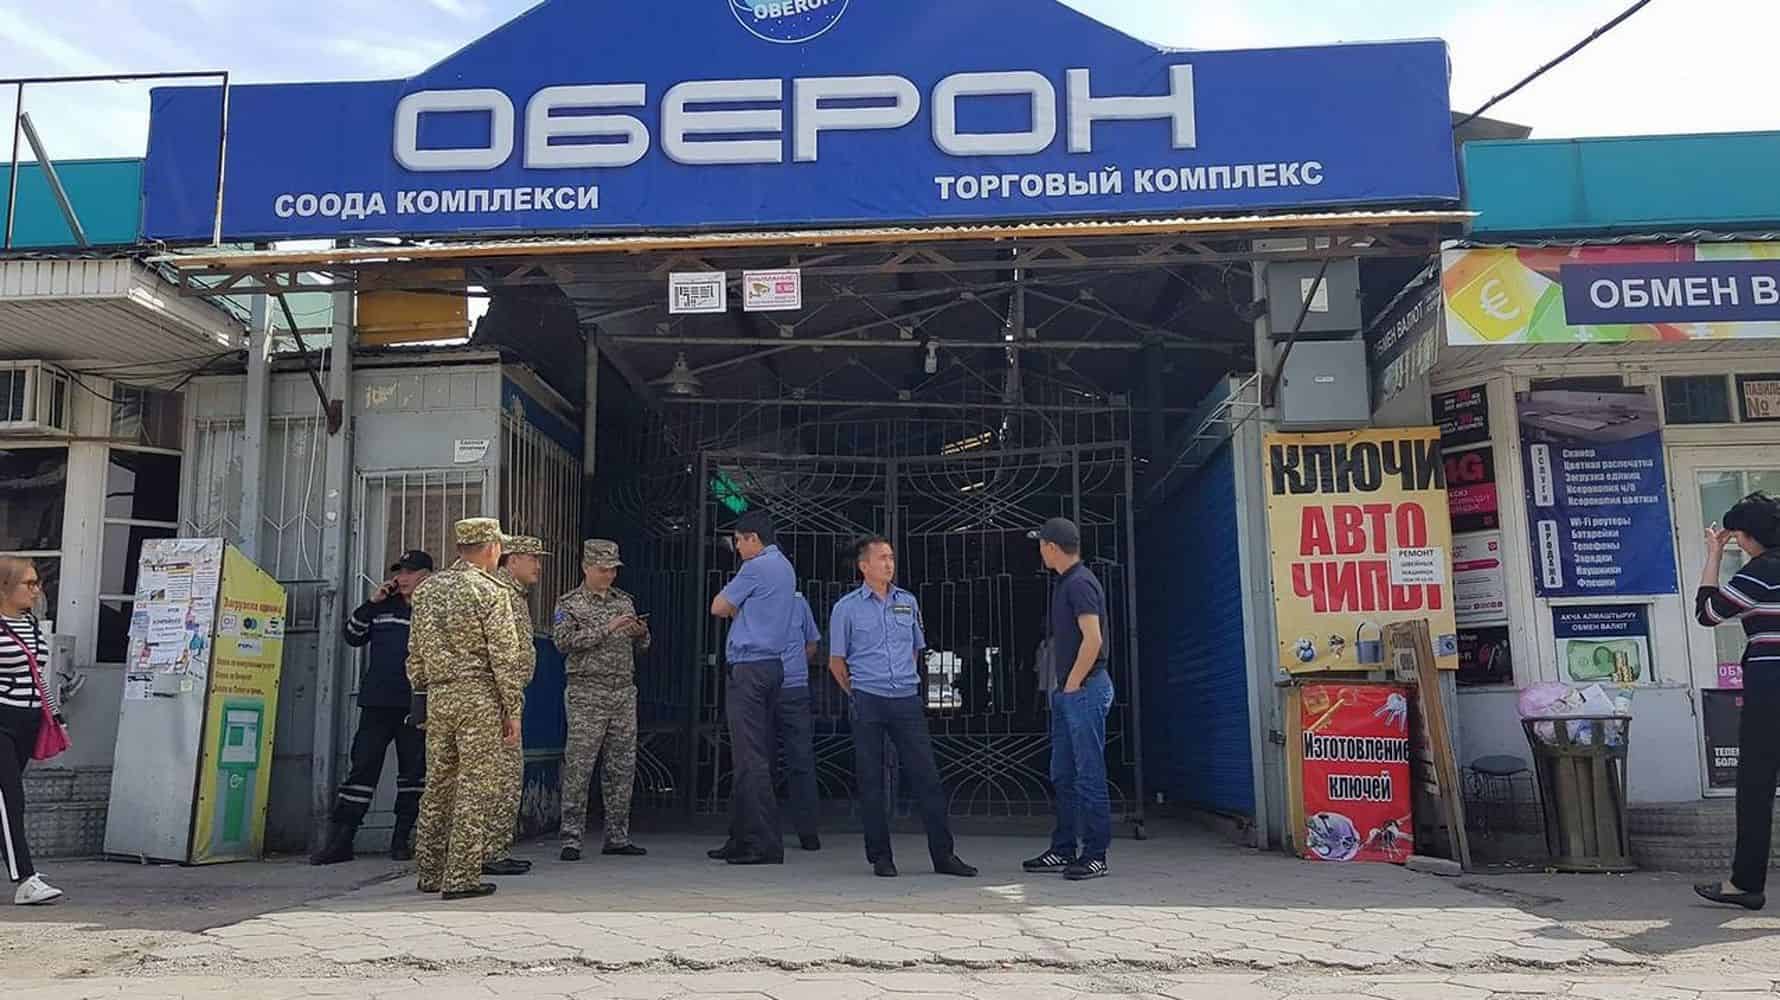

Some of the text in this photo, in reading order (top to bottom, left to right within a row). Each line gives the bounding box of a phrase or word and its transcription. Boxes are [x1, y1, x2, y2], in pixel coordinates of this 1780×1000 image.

[393, 63, 1197, 172] ОБЕРОН
[935, 161, 1324, 200] ТОРГОВЫЙ КОМПЛЕКС
[274, 186, 599, 219] СООДА КОМПЛЕКСИ
[1590, 275, 1780, 309] ОБМЕН В
[1270, 439, 1446, 495] КЛЮЧИ
[1602, 459, 1653, 470] распечатка
[1566, 472, 1641, 483] Загрузка единиц
[1566, 485, 1619, 495] Ксерокопия
[1568, 495, 1658, 506] Ксерокопия цветная
[1300, 502, 1428, 557] АВТО
[1571, 529, 1619, 539] Батарейки
[1399, 549, 1434, 557] РЕМОНТ
[1572, 541, 1620, 551] Телефоны
[1572, 623, 1600, 631] ОБМЕН
[1303, 731, 1409, 763] Изготовление
[1328, 771, 1392, 802] ключей
